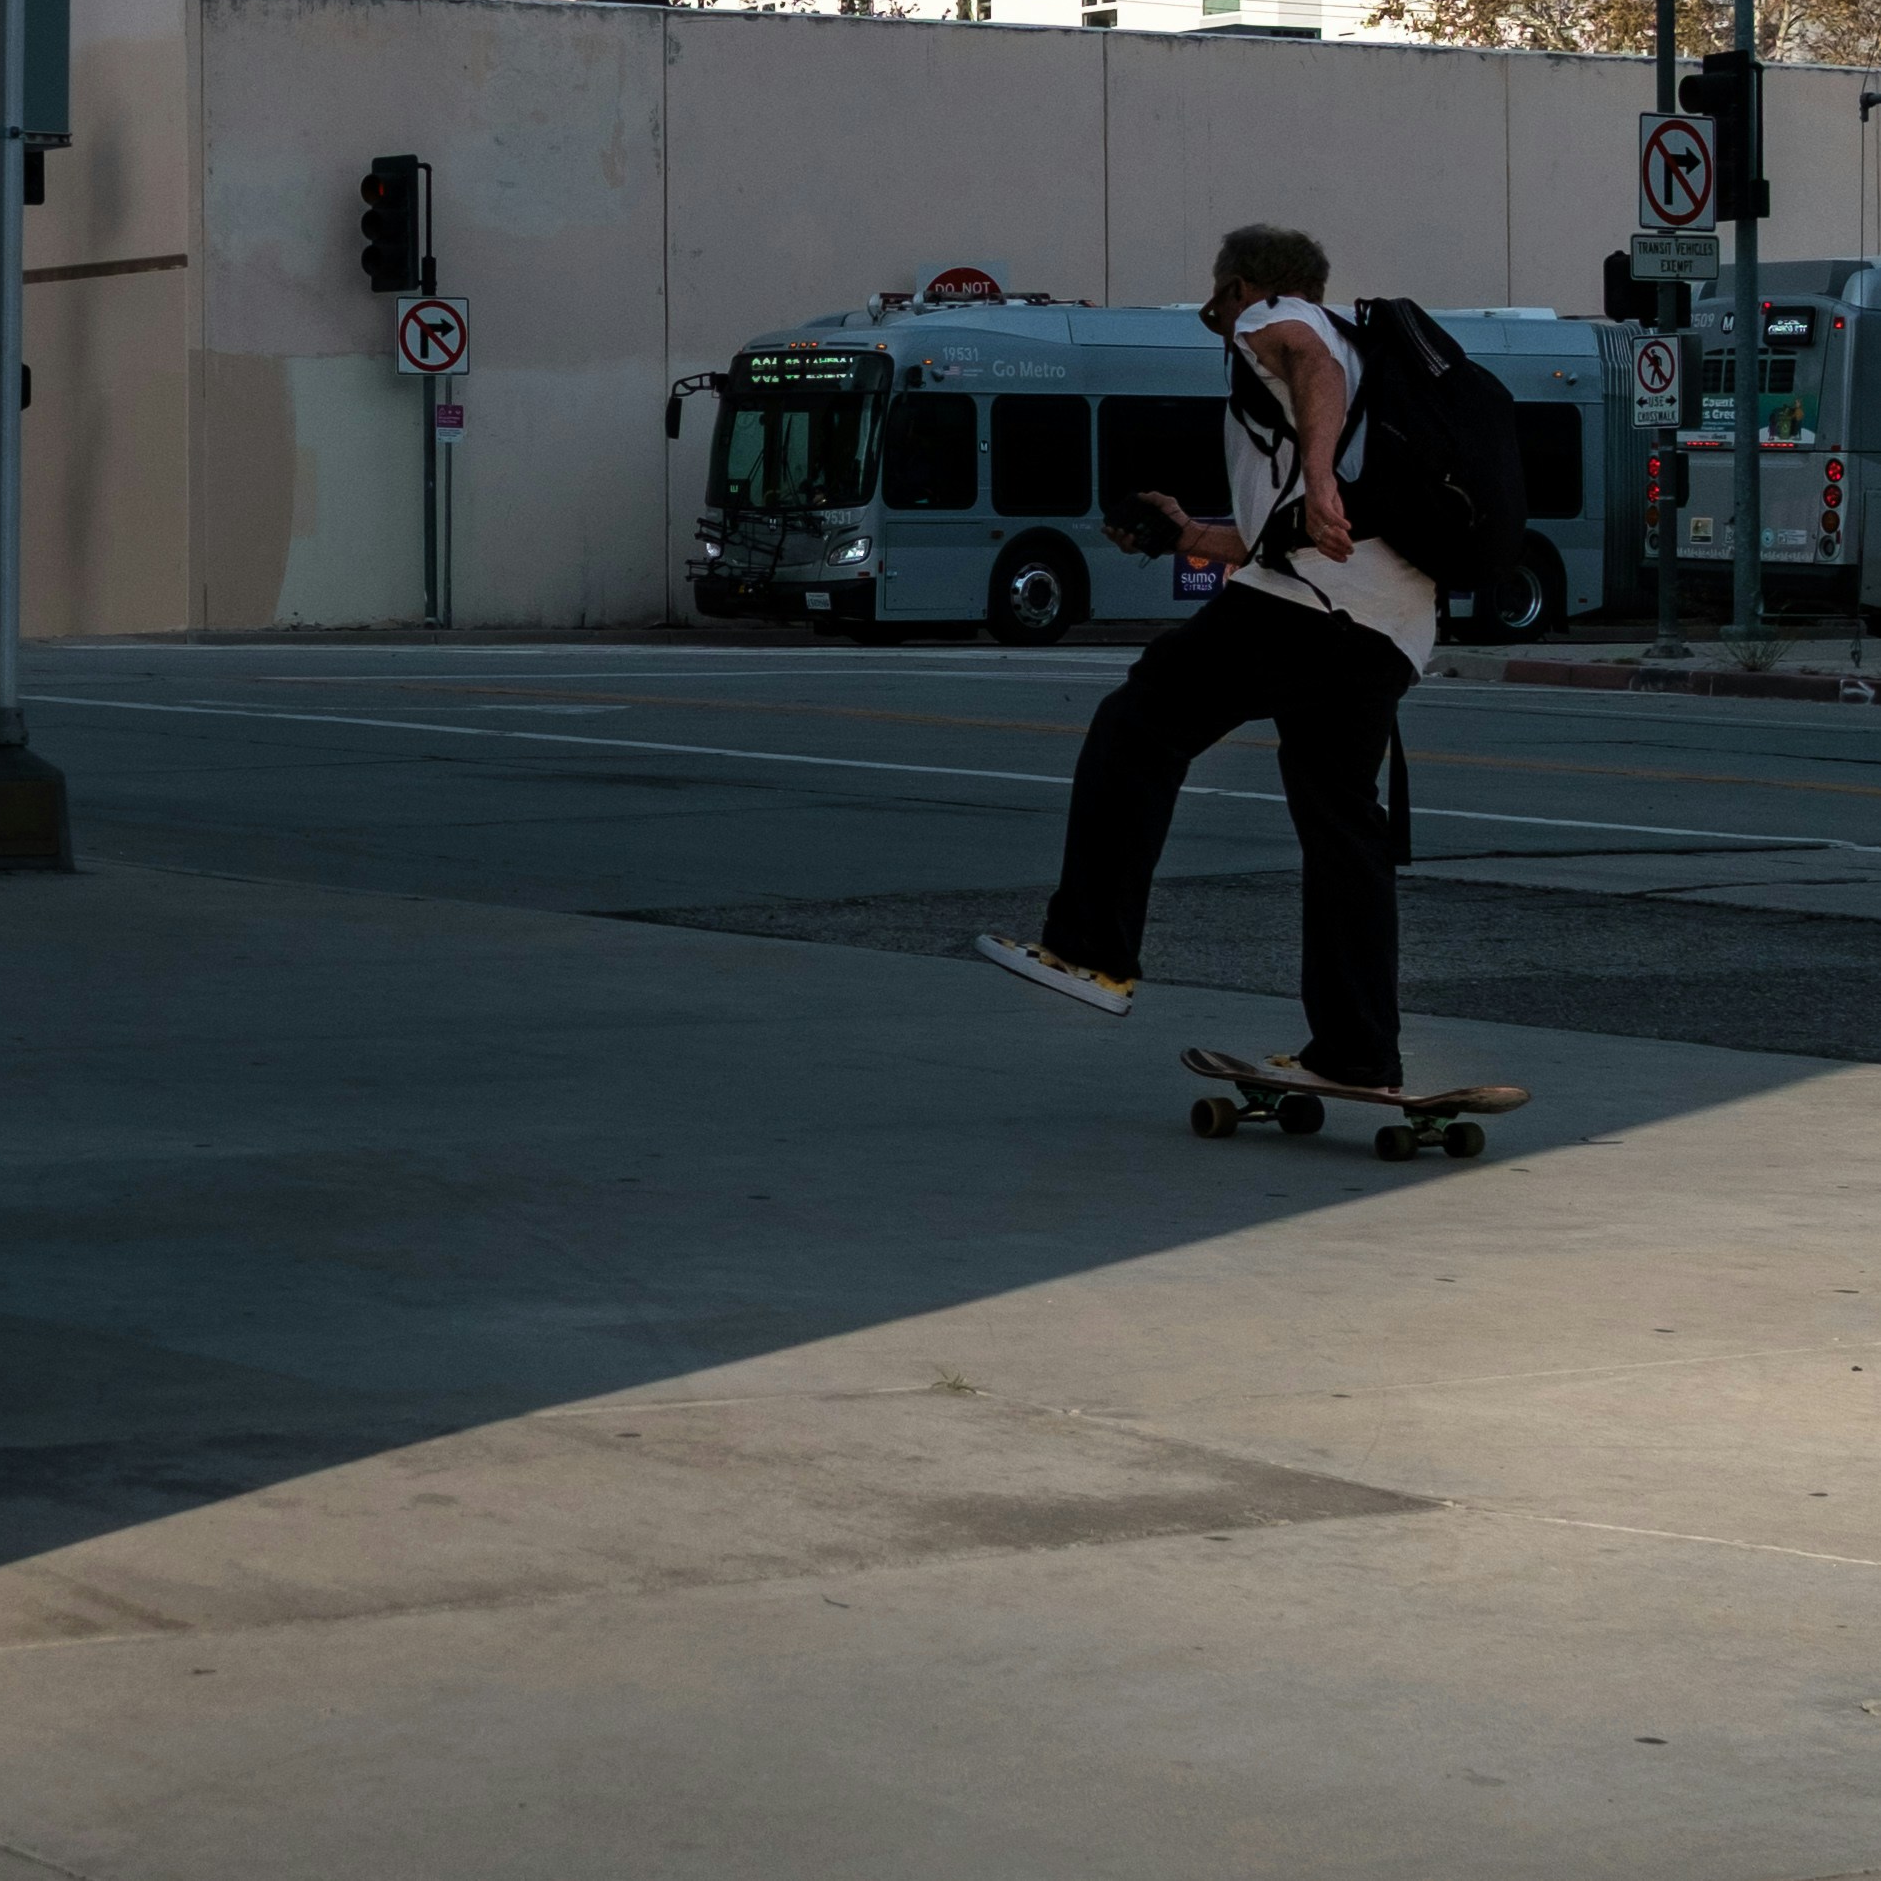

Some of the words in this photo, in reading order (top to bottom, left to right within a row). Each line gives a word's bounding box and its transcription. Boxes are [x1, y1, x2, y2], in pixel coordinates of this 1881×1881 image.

[1638, 241, 1672, 255] TRANSIT
[1674, 242, 1714, 256] VEHICLES
[1660, 260, 1693, 273] EXEMPT
[934, 283, 955, 293] DO
[962, 281, 991, 294] NOT
[942, 345, 979, 362] 19531
[992, 359, 1015, 377] Go
[1019, 360, 1066, 378] Metro
[1648, 395, 1665, 408] USE
[1637, 410, 1676, 423] CROSSWALK
